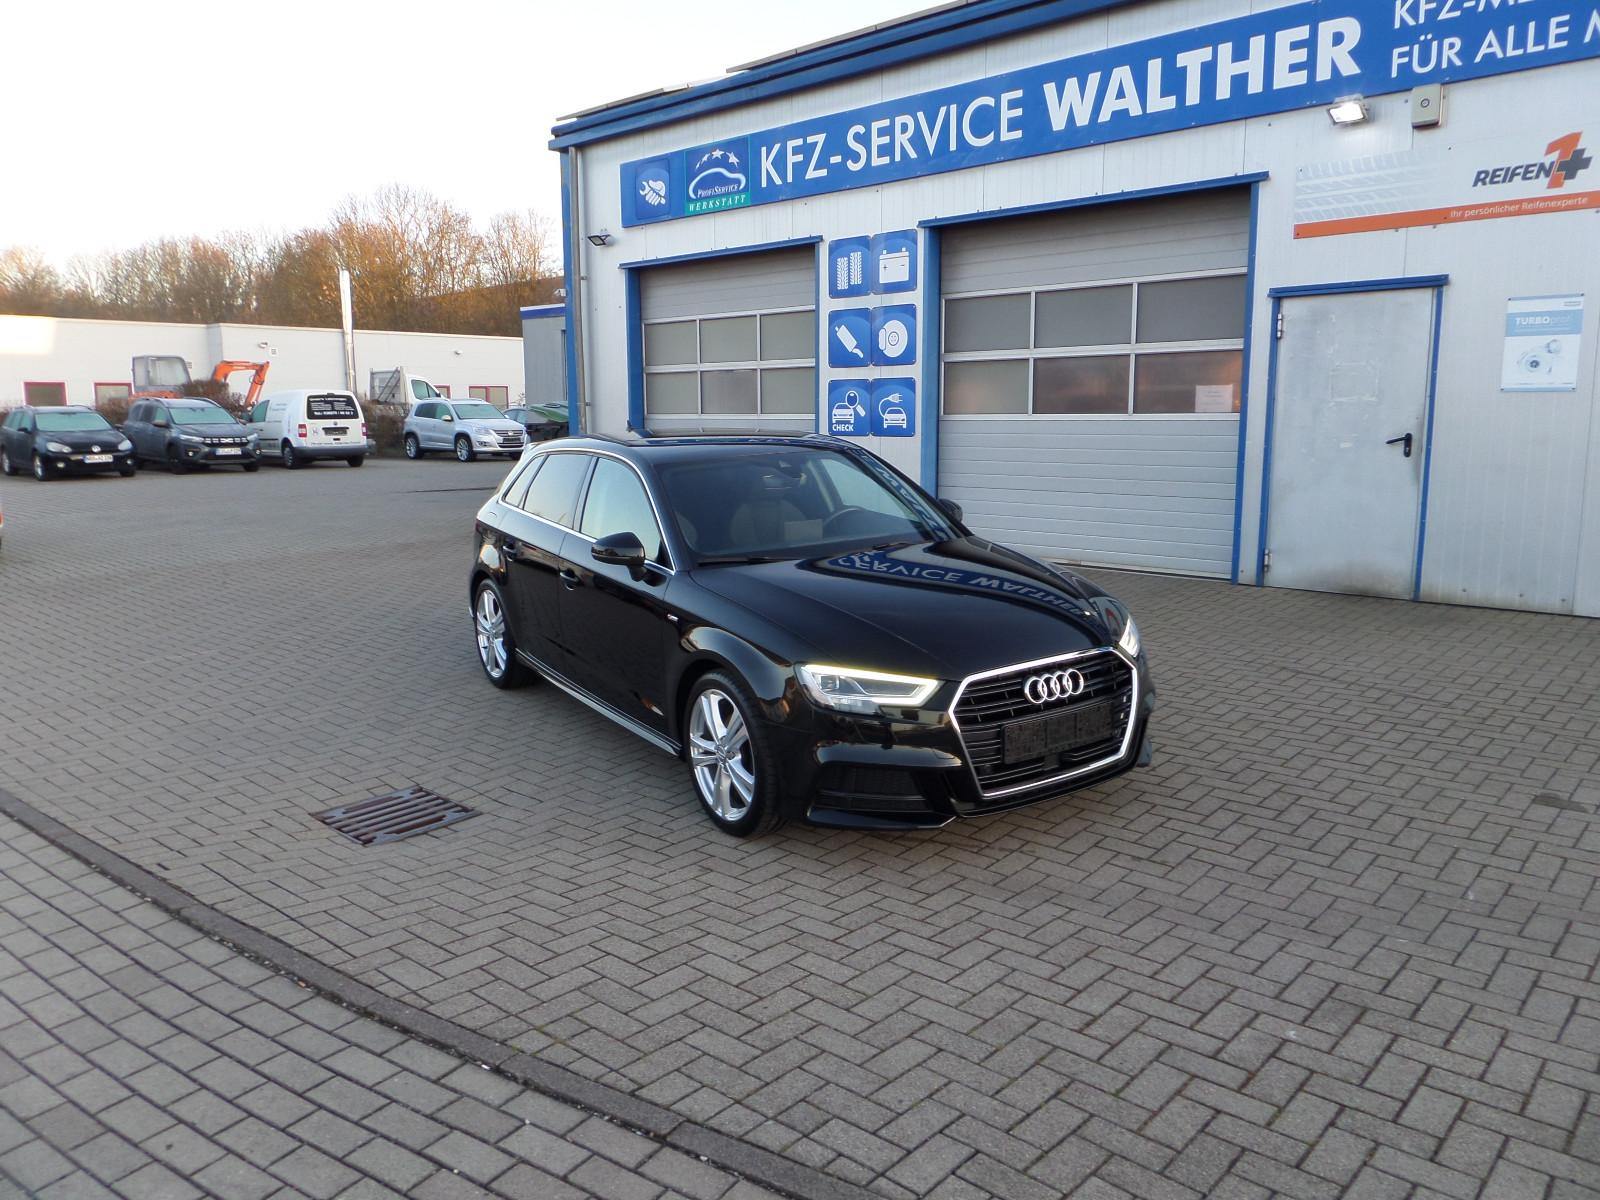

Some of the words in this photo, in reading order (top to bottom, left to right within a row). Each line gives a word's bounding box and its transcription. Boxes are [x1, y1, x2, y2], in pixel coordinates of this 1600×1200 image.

[1391, 33, 1463, 79] FÜR
[1474, 14, 1570, 64] ALLE
[761, 89, 1023, 188] KFZ-SERVICE
[1043, 17, 1361, 131] WALTHER
[689, 194, 746, 212] WERKSTATT
[1450, 209, 1463, 218] Ihr
[1464, 204, 1520, 217] persönlicher
[1521, 197, 1588, 211] Reifenexperte
[832, 423, 854, 432] CHECK
